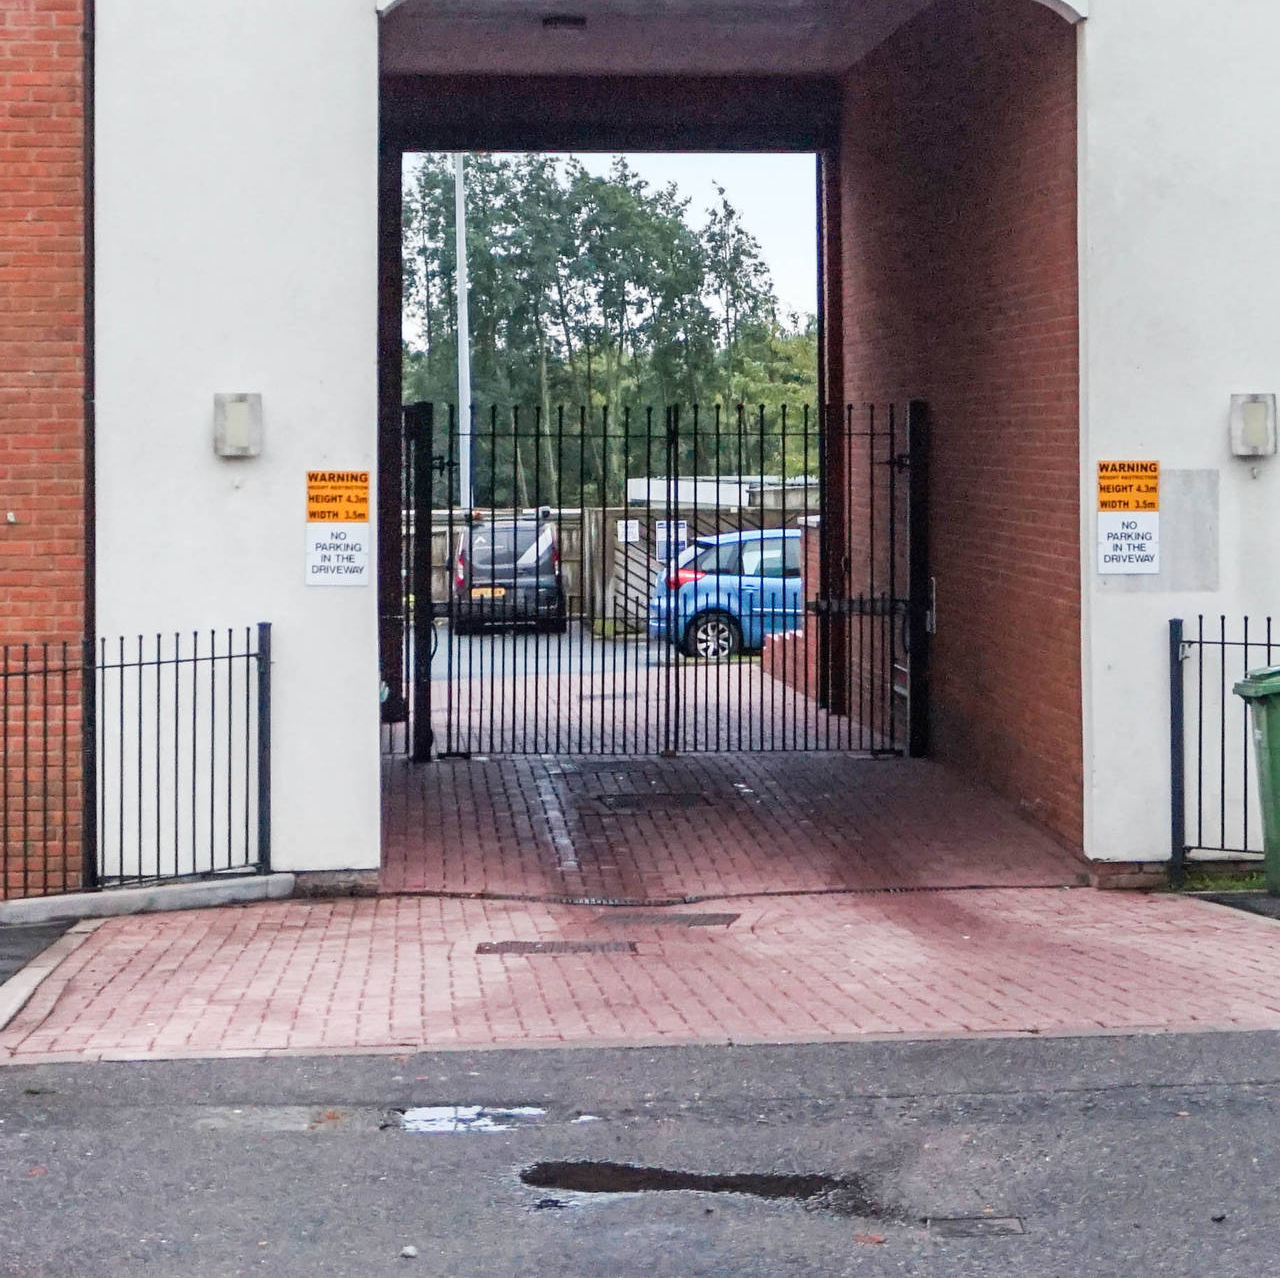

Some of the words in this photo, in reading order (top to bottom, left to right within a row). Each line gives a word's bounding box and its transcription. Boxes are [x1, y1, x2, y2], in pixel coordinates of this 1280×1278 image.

[1099, 462, 1158, 473] WARNING
[307, 472, 368, 483] WARNING
[1099, 484, 1134, 493] HEIGHT
[1136, 484, 1157, 493] 4.3m
[307, 494, 343, 504] HEIGHT
[1099, 500, 1130, 509] WIDTH
[1134, 500, 1156, 509] 3.5m
[308, 510, 339, 519] WIDTH
[1121, 520, 1138, 530] NO
[330, 531, 347, 540] NO
[1106, 531, 1153, 541] PARKING
[315, 542, 362, 552] PARKING
[1112, 542, 1123, 552] IN
[1126, 542, 1146, 552] THE
[320, 553, 331, 563] IN
[335, 553, 356, 563] THE
[1103, 554, 1156, 563] DRIVEWAY
[311, 564, 365, 574] DRIVEWAY
